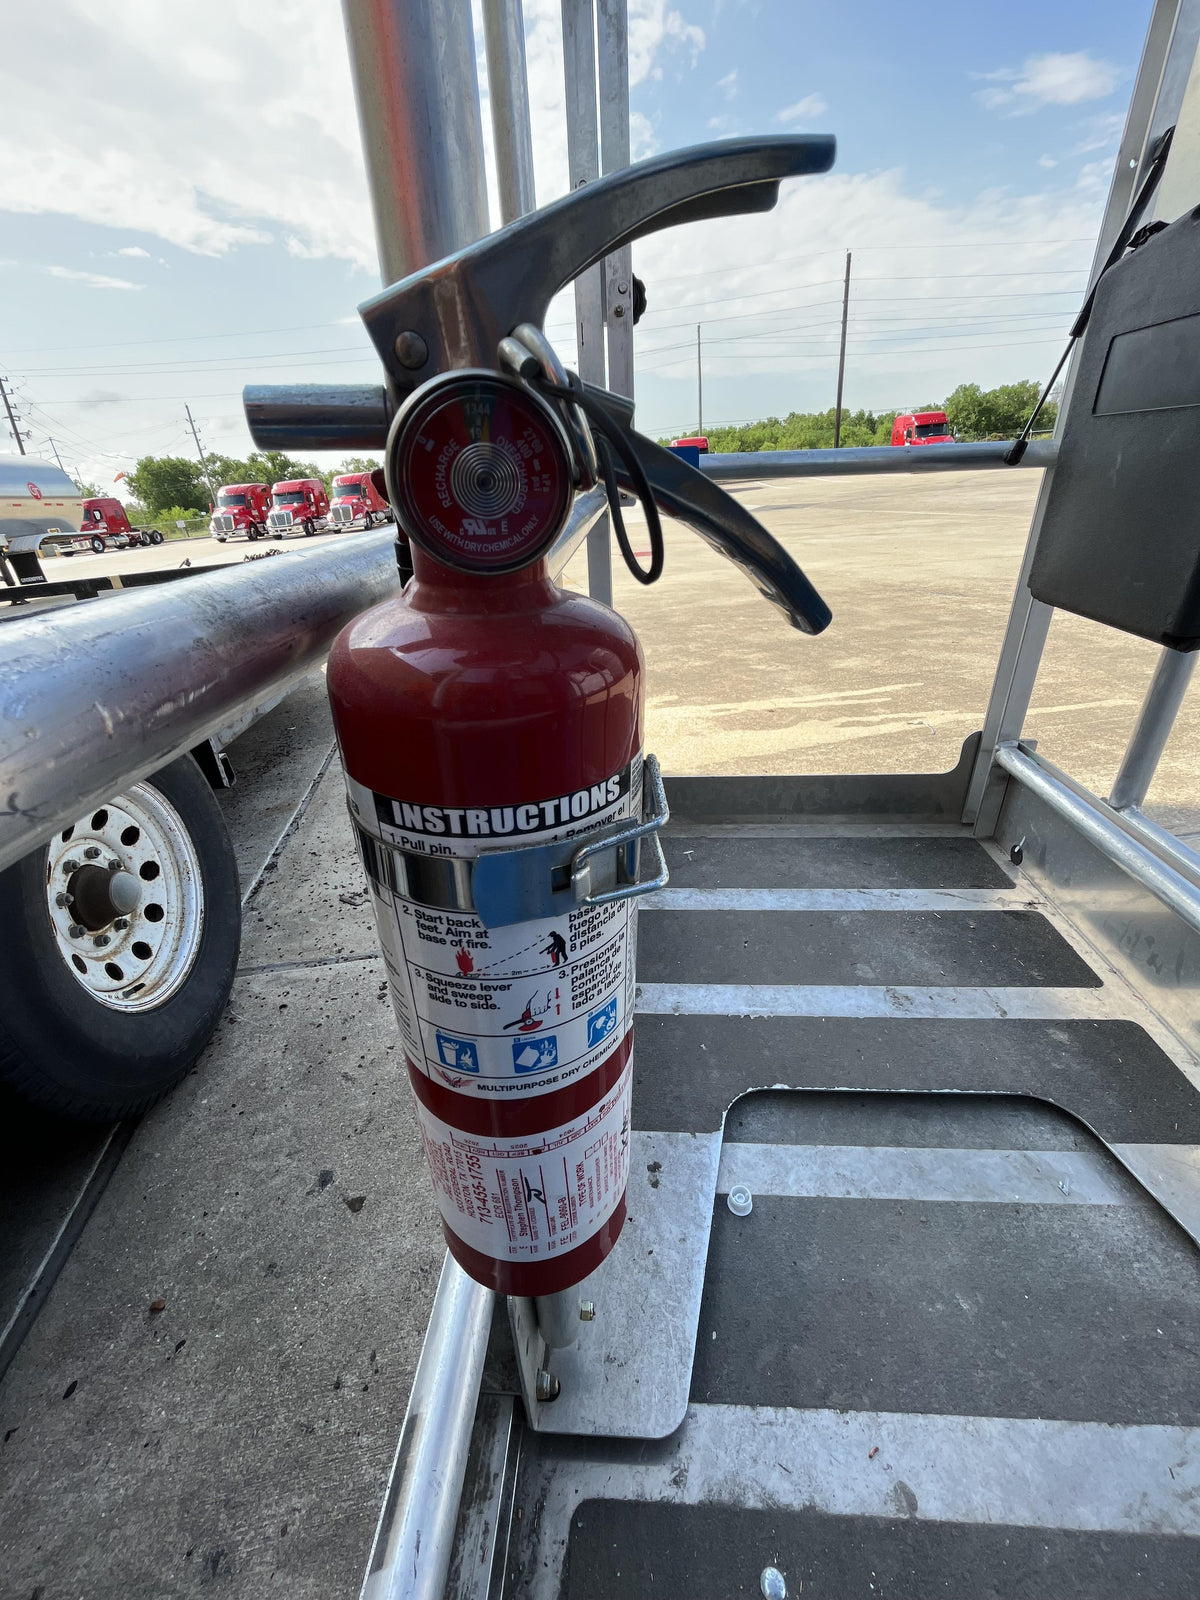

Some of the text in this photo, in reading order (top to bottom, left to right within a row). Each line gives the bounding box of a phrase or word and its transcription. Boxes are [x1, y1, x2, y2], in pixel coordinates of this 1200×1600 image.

[435, 438, 461, 508] RECHARGE
[497, 436, 528, 515] OVERCHARGED
[429, 514, 539, 553] USE WITH DRY CHEMICAL ONLY
[392, 775, 620, 835] INSTRUCTIONS
[402, 836, 426, 852] Pull
[430, 843, 457, 856] pin.
[403, 900, 481, 929] 2. Start back
[569, 912, 601, 932] fuego
[570, 900, 626, 943] distancia de
[416, 919, 489, 939] feet. Aim at
[418, 930, 492, 949] base of fire.
[570, 931, 604, 952] 8 pies.
[559, 970, 570, 979] 3.
[571, 940, 618, 974] Presionar
[571, 945, 621, 986] palanca de
[426, 973, 477, 991] Squeeze
[480, 983, 512, 992] lever
[571, 965, 607, 993] control
[571, 971, 612, 1001] esparcir
[427, 984, 492, 1003] and sweep
[429, 992, 500, 1010] side to side.
[572, 993, 594, 1010] lado
[477, 1034, 620, 1092] MULTIPURPOSE DRY CHEMICAL
[576, 1161, 585, 1180] WORK
[466, 1154, 494, 1224] 713-455-1755
[579, 1190, 587, 1207] TYPE
[493, 1204, 504, 1219] ECR
[511, 1178, 528, 1237] Stephen Thompson
